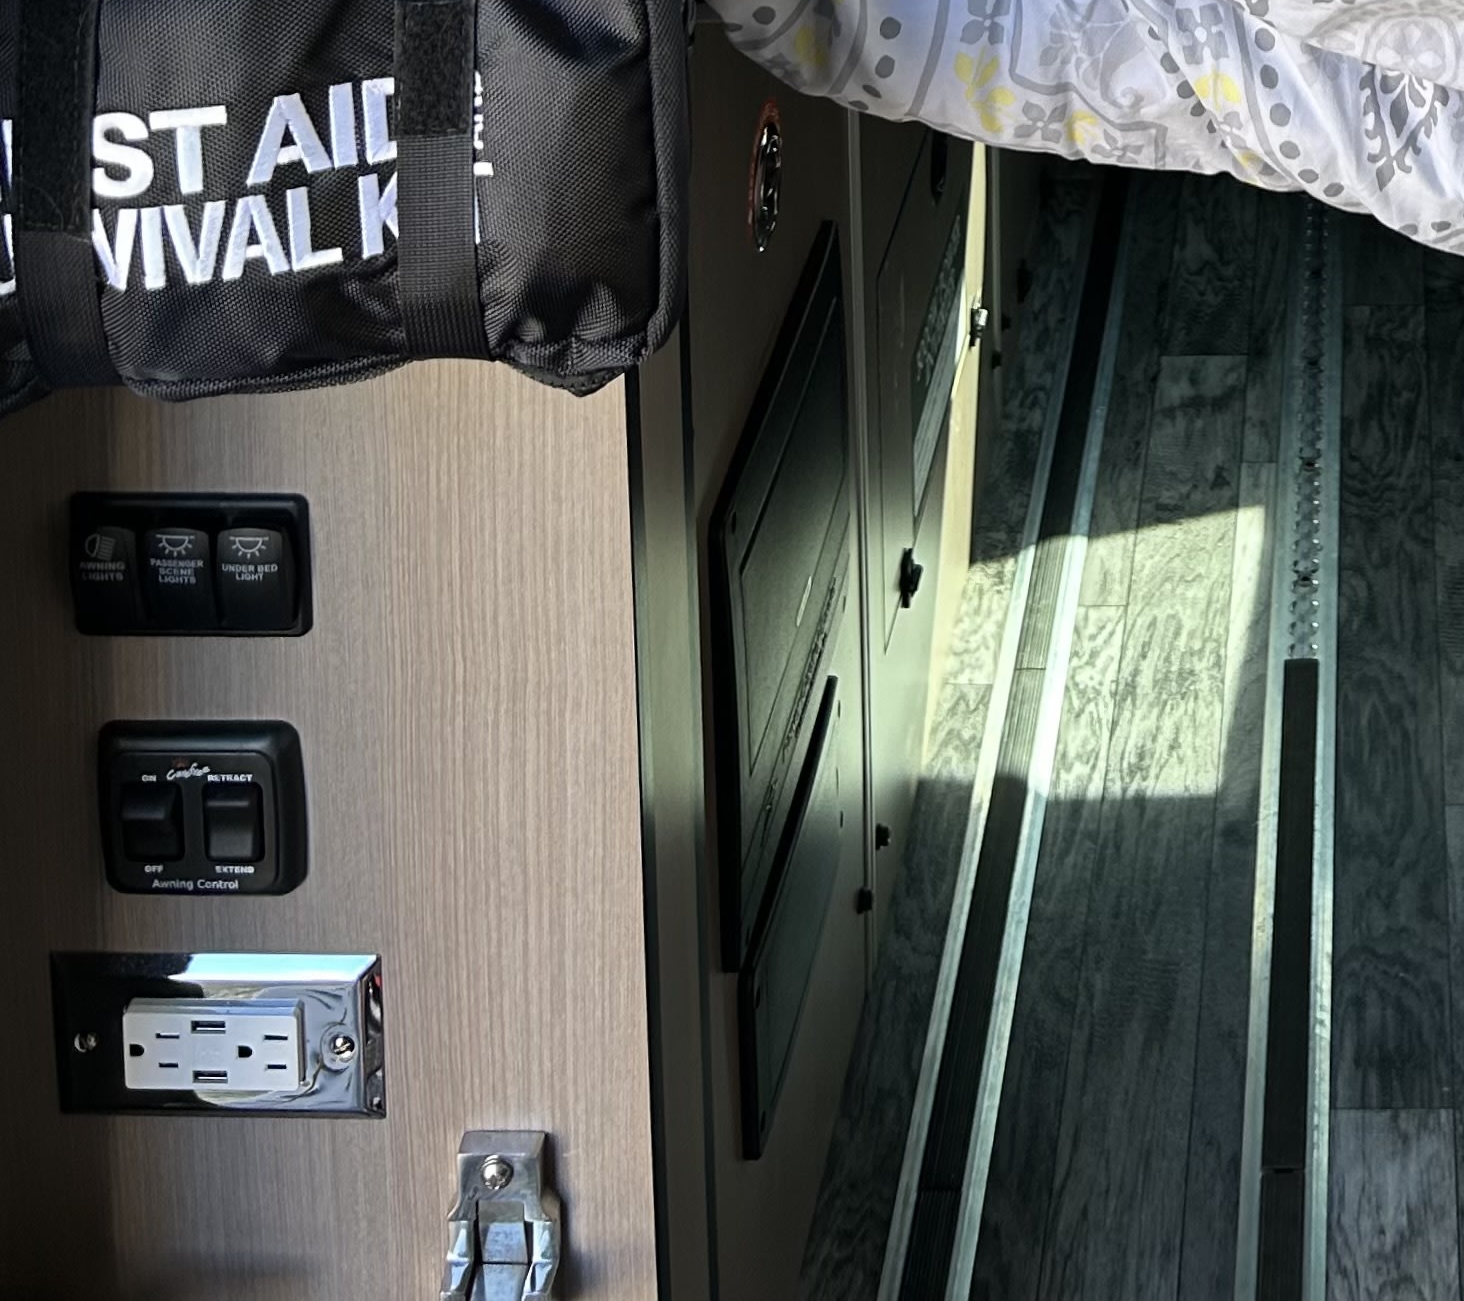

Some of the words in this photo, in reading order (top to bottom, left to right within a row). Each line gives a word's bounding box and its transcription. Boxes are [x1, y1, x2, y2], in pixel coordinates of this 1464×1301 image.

[91, 187, 344, 291] VIVAL
[150, 558, 204, 568] PASSENGER
[221, 563, 254, 573] UNDER
[257, 564, 278, 573] BED
[158, 575, 196, 584] LIGHTS
[235, 572, 264, 581] LIGHT
[207, 774, 253, 782] RETRACT
[144, 864, 164, 873] OFF
[214, 865, 255, 874] EXTEND
[152, 879, 194, 891] Awning
[197, 879, 239, 889] Control
